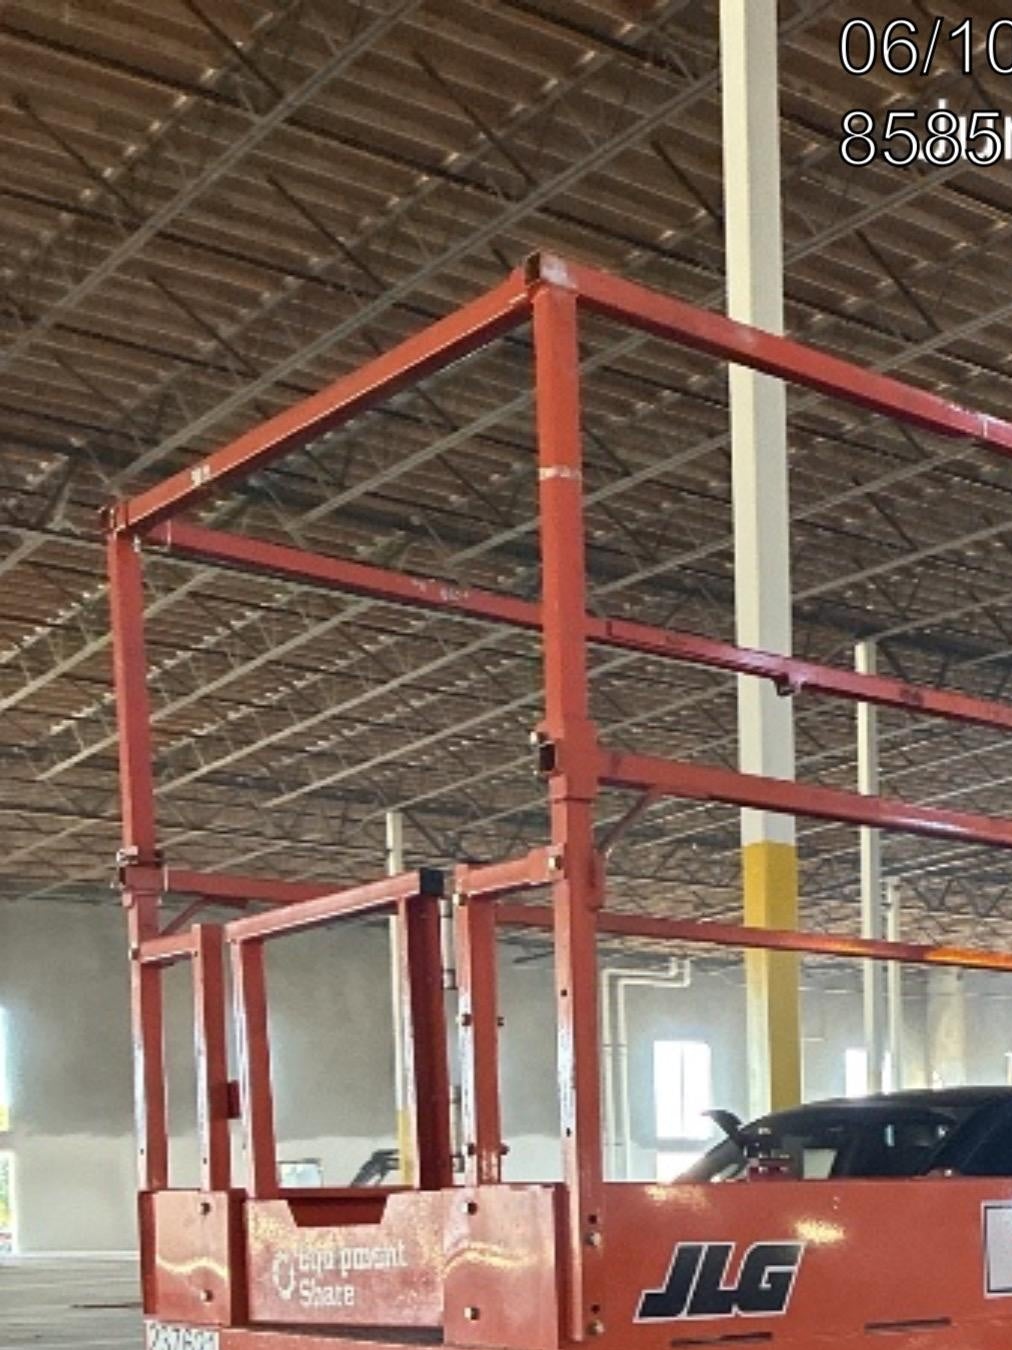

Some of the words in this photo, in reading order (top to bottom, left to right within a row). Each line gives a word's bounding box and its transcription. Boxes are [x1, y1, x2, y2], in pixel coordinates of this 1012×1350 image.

[297, 1240, 409, 1279] Equpment
[299, 1277, 355, 1308] Share
[633, 1241, 806, 1323] JLG
